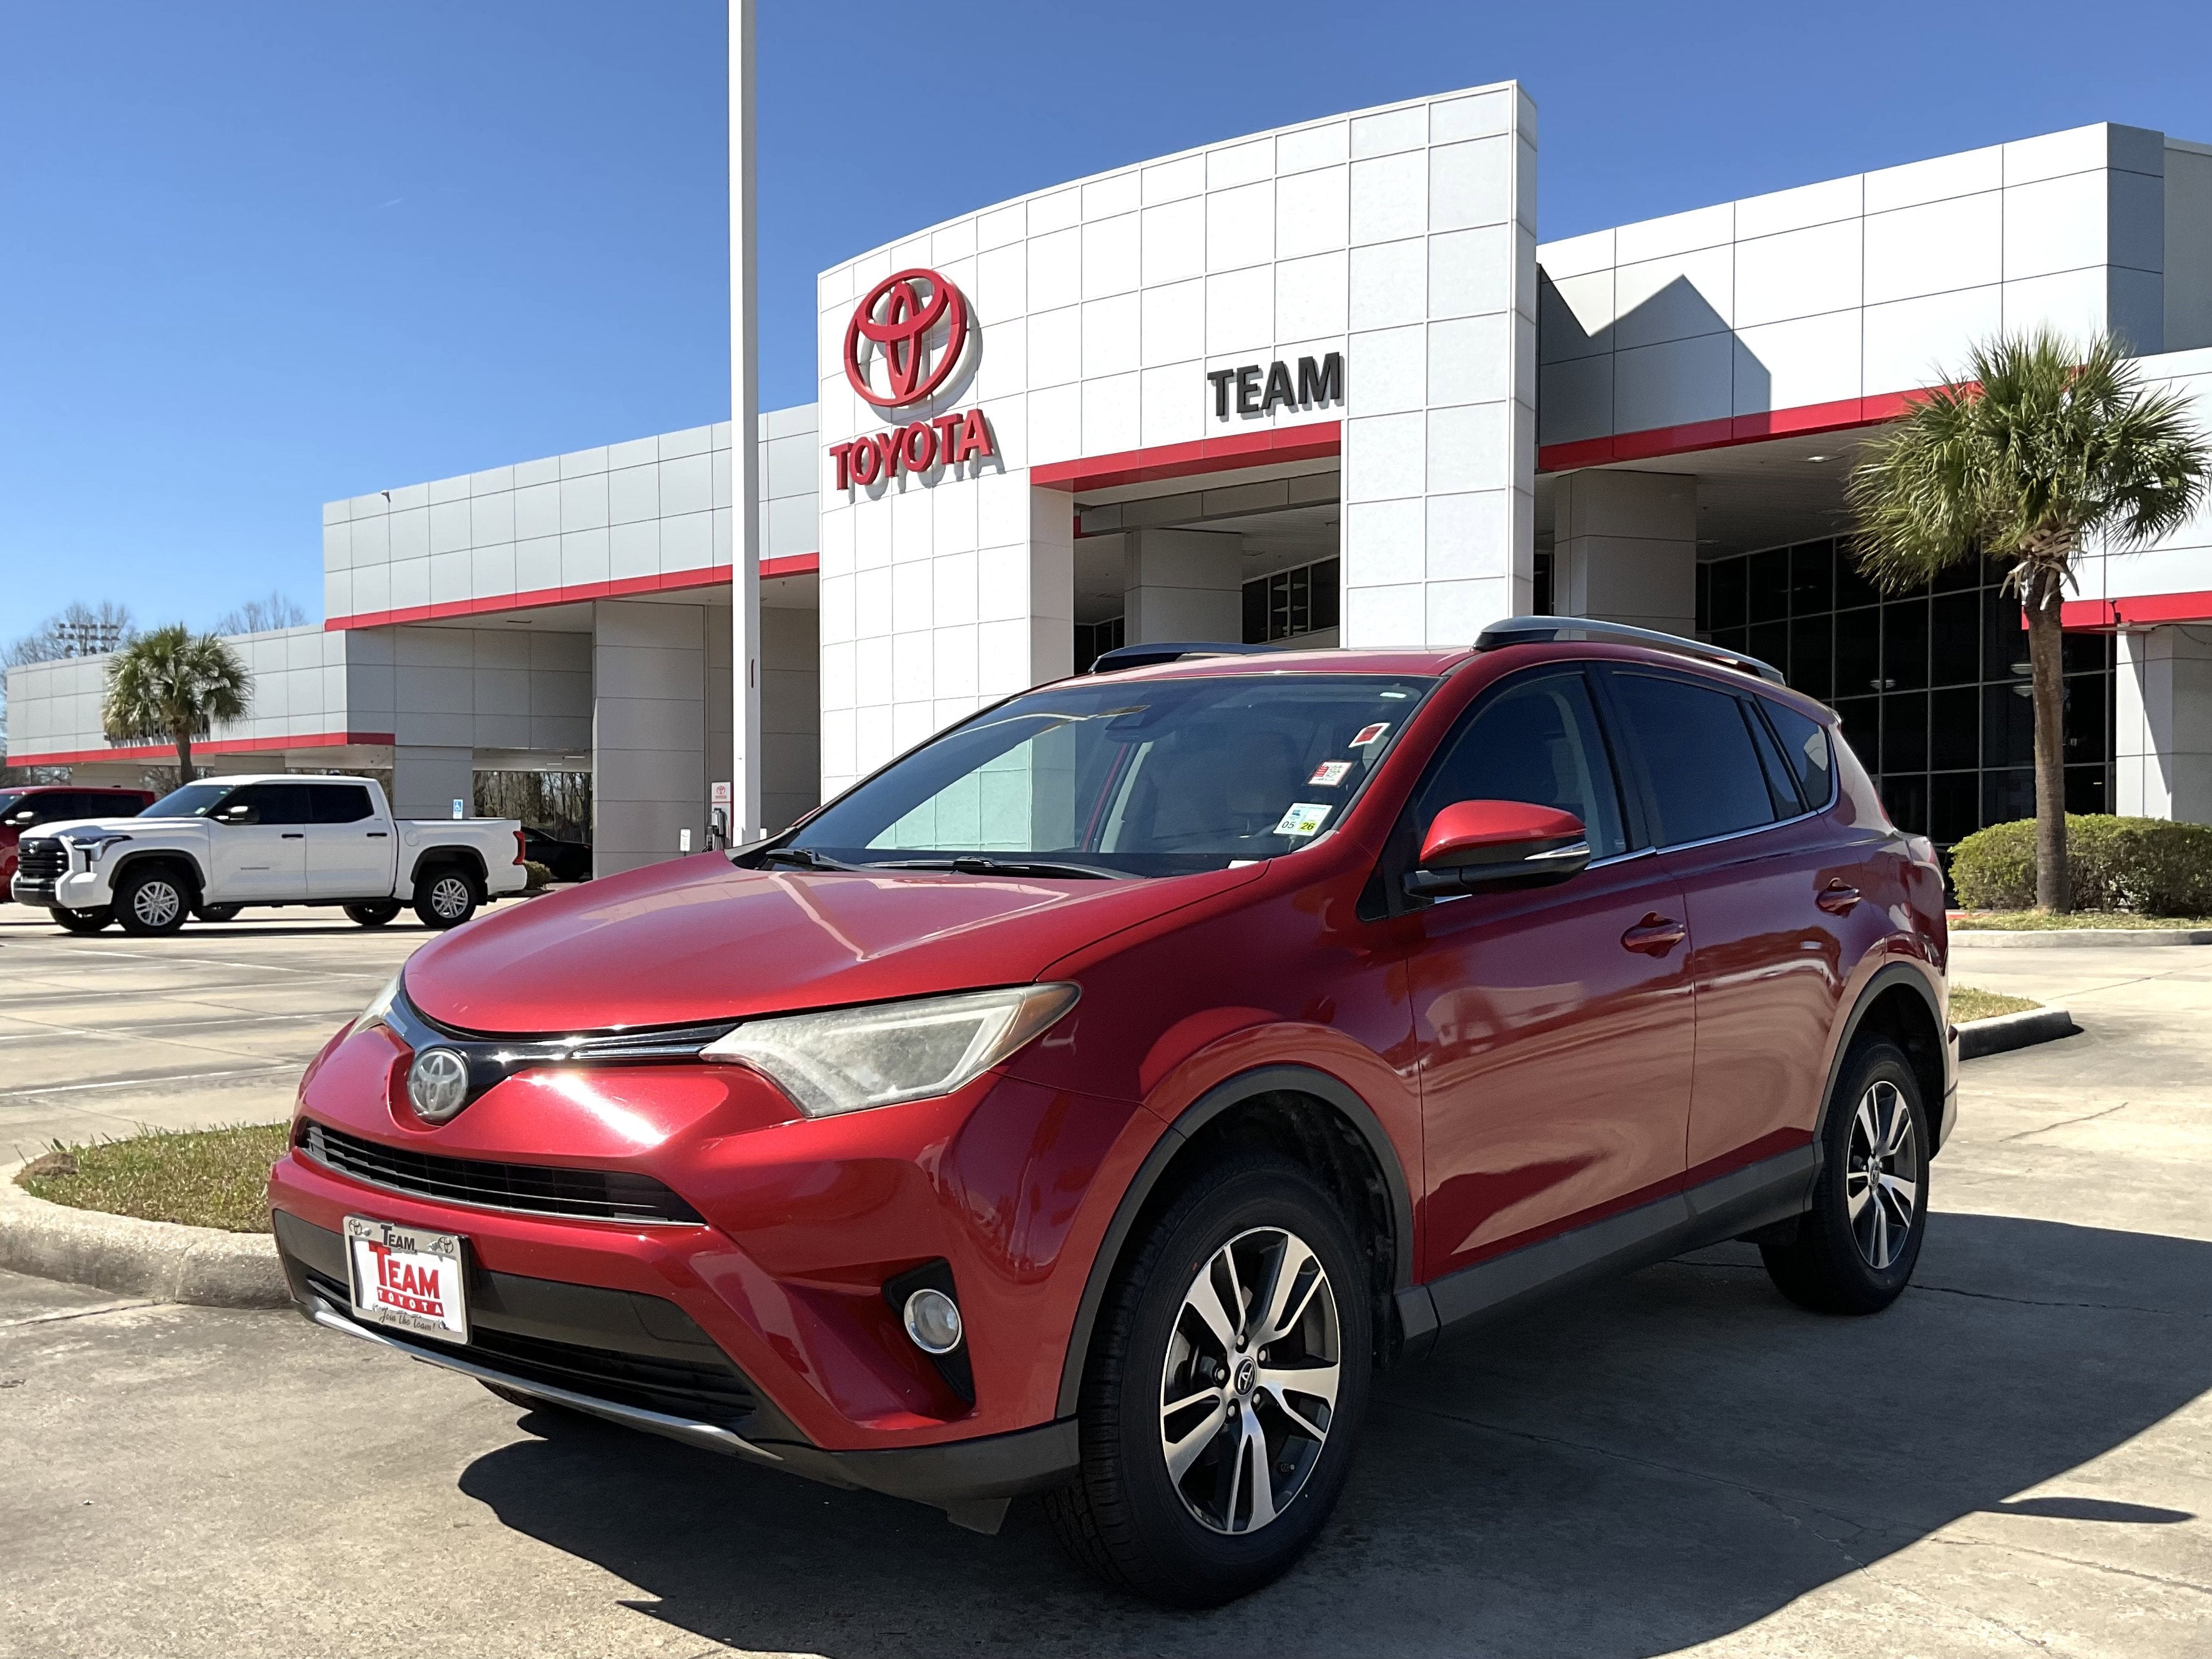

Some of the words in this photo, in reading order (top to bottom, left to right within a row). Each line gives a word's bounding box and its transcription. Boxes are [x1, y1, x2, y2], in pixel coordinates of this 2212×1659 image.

[1207, 352, 1339, 416] TEAM
[830, 409, 993, 490] TOYOTA
[1281, 821, 1296, 829] 05
[1300, 822, 1315, 830] 26
[368, 1240, 440, 1299] TEAM
[378, 1290, 442, 1314] TOYOTA
